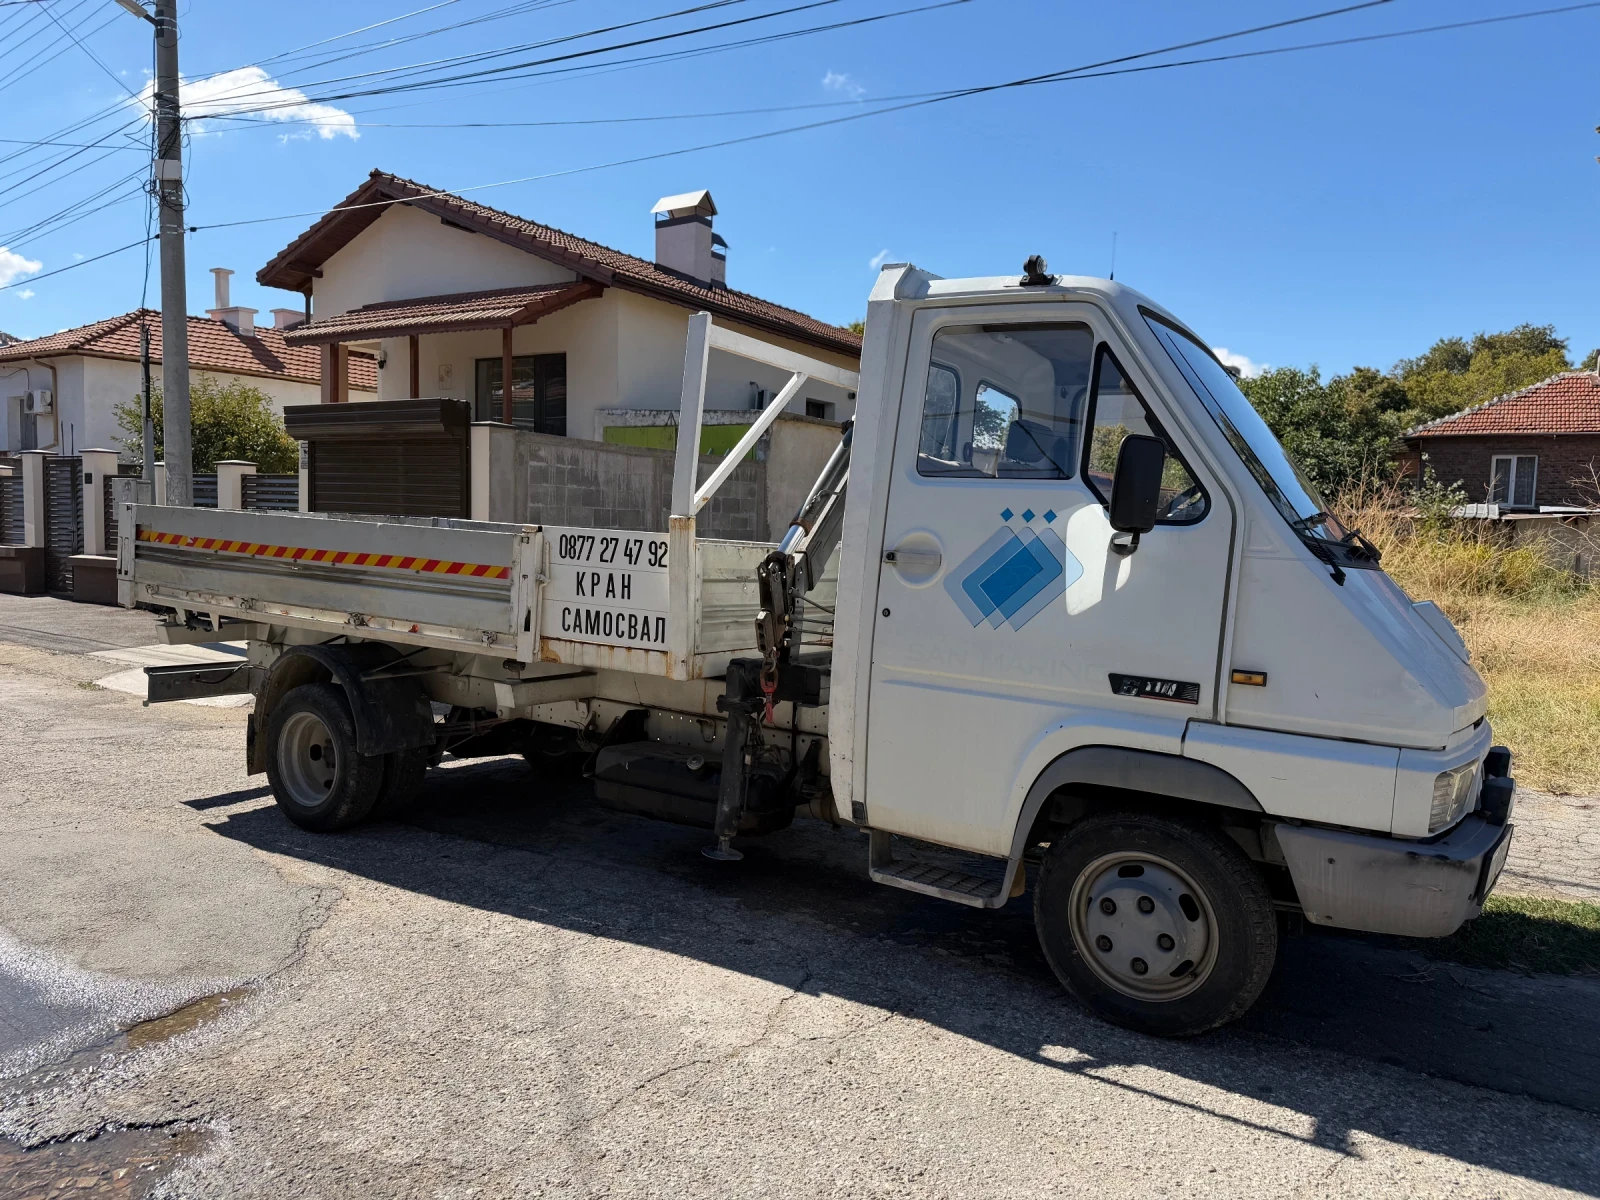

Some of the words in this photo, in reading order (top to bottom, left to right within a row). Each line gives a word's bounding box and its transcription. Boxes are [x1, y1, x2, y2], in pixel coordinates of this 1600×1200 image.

[559, 533, 596, 562] 0877
[599, 536, 620, 564] 27
[623, 538, 644, 566] 47
[648, 540, 669, 568] 92
[576, 571, 632, 600] КРАН
[561, 606, 666, 644] САМОСВАЛ
